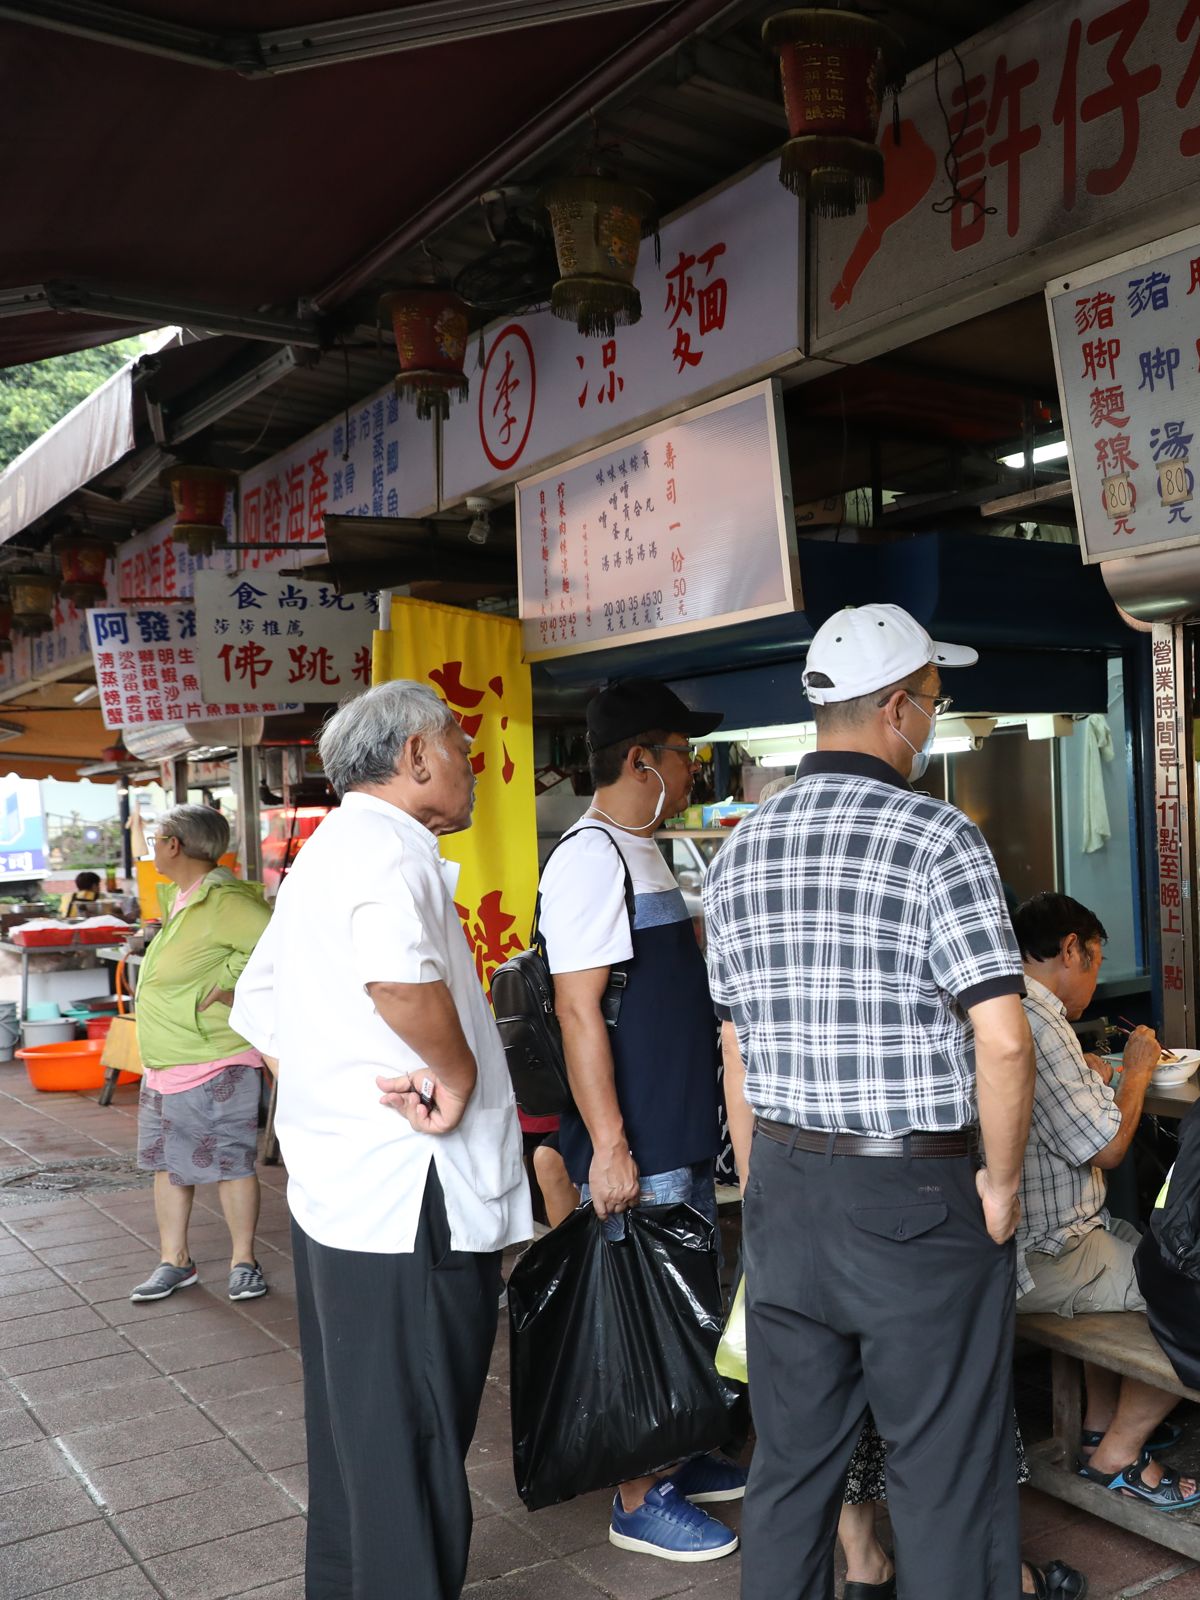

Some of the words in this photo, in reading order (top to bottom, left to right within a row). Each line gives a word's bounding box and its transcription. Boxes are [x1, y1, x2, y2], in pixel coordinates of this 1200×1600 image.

[213, 618, 305, 639] 莎莎推薦
[1153, 640, 1183, 991] 營業時間早上11點至晚上點
